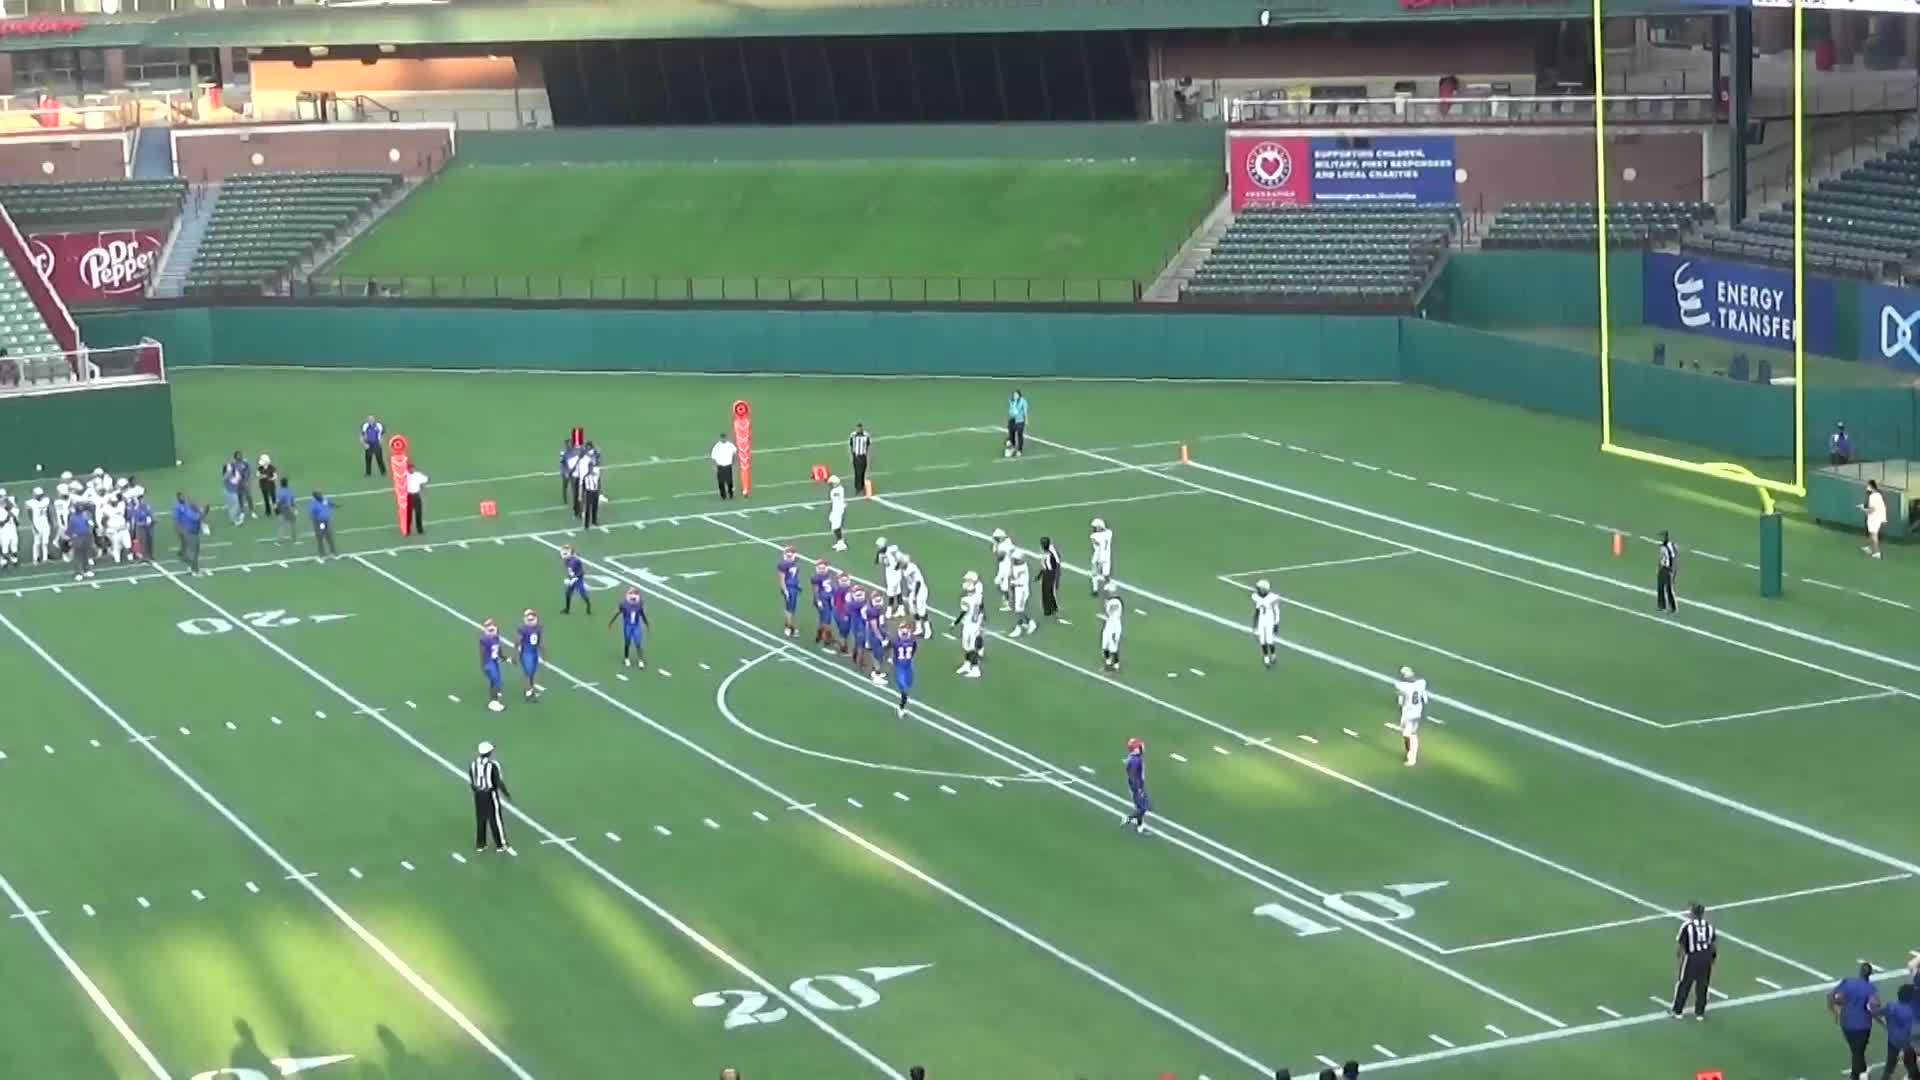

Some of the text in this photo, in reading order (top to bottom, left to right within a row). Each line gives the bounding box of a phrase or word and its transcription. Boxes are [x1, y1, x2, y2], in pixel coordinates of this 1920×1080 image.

[1314, 149, 1374, 159] SUPPORTING
[1361, 160, 1389, 168] FIRST
[1314, 170, 1419, 179] AND LOCAL CHARITIES
[108, 240, 139, 265] Dr
[1717, 280, 1784, 312] ENERGY
[176, 608, 301, 625] 20
[1253, 890, 1416, 937] 10
[692, 974, 881, 1030] 20
